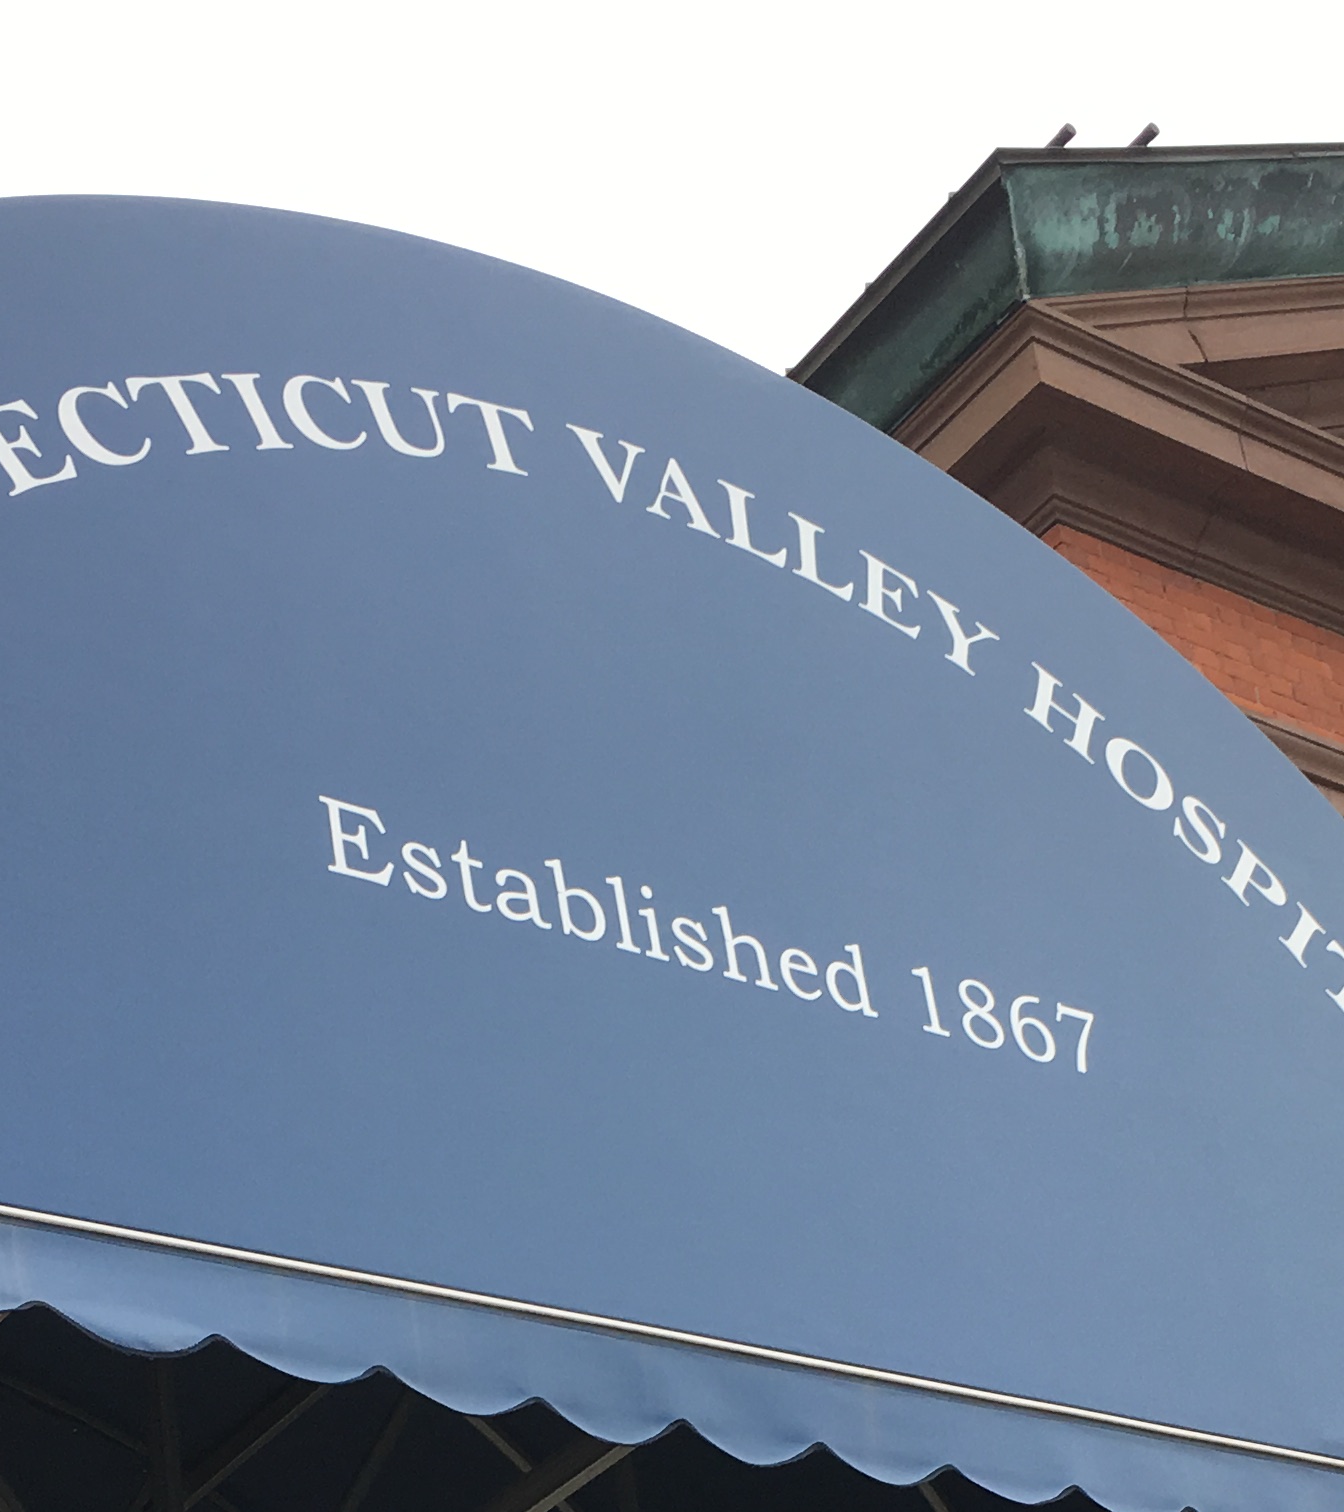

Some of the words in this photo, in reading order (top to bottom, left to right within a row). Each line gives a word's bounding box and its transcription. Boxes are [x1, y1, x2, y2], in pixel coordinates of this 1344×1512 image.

[566, 423, 1000, 676] VALLEY
[318, 794, 879, 1018] Established
[910, 965, 1095, 1074] 1867
